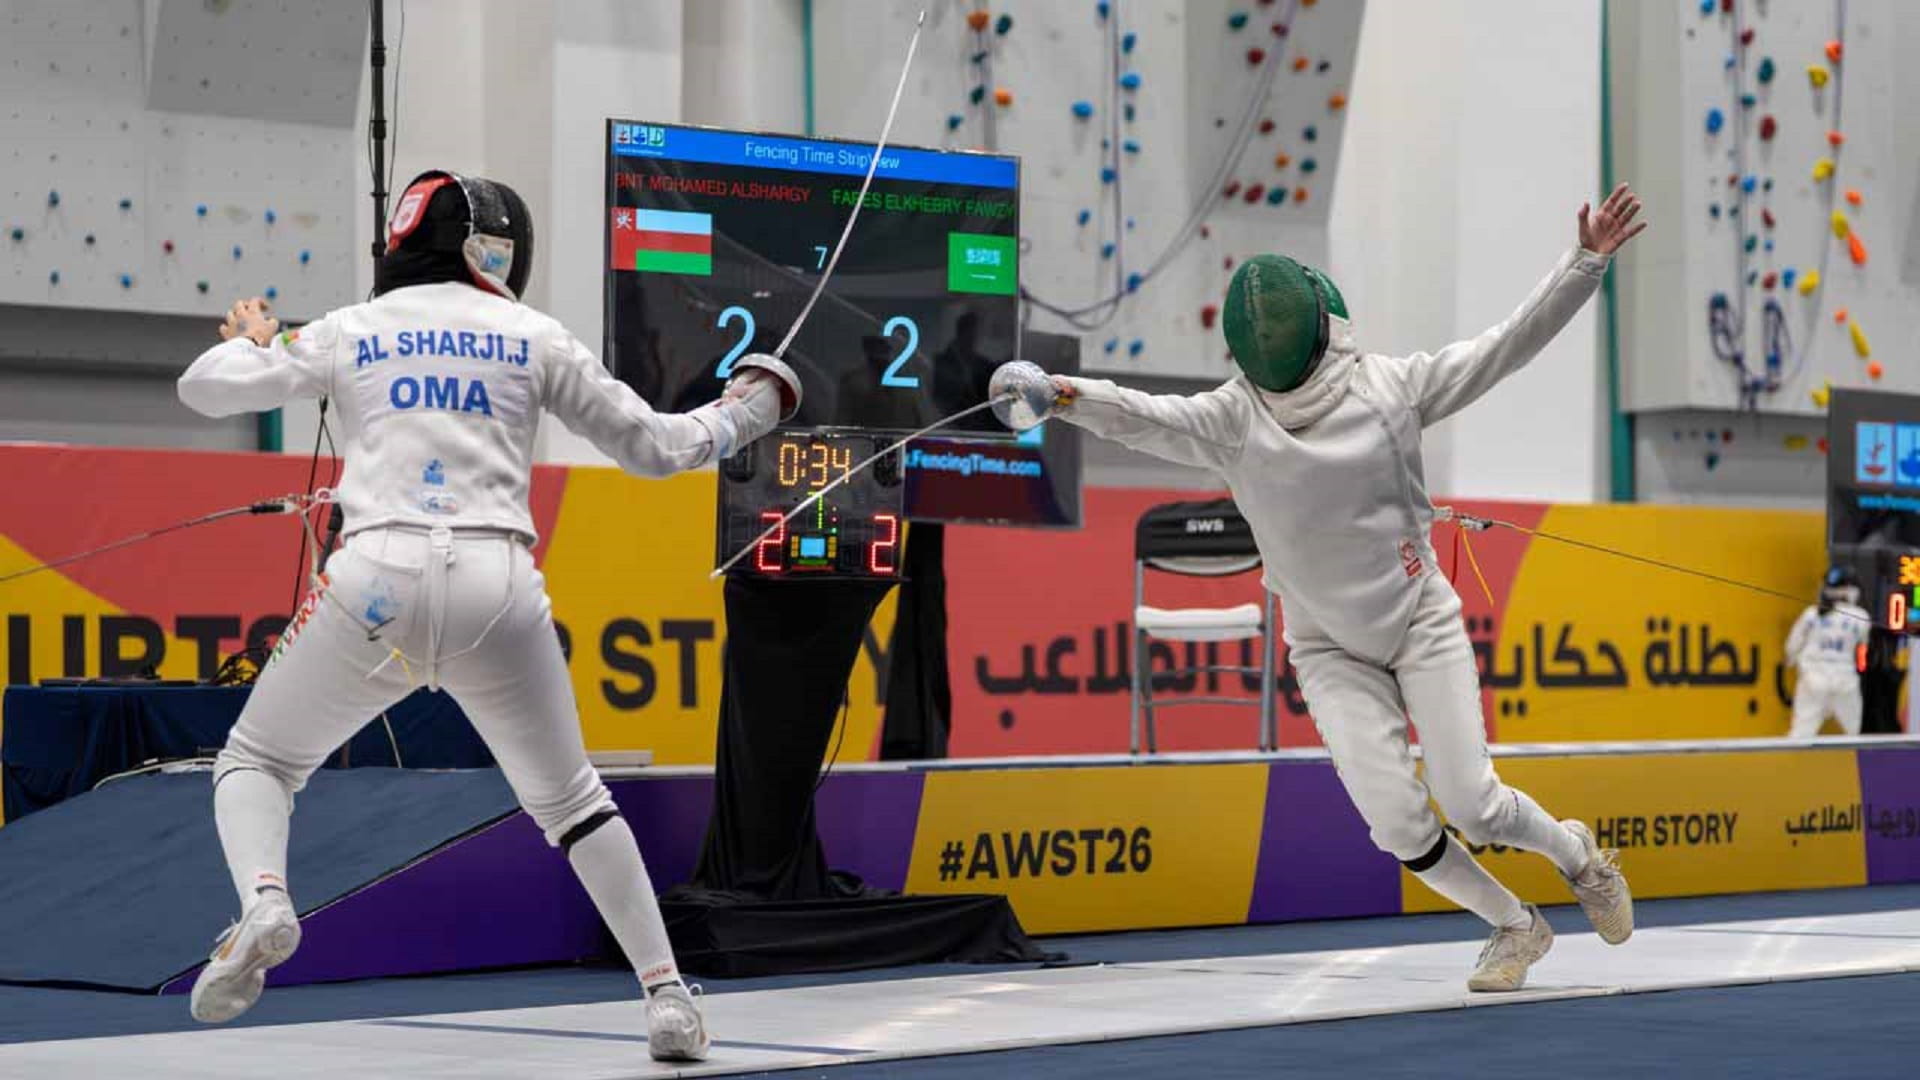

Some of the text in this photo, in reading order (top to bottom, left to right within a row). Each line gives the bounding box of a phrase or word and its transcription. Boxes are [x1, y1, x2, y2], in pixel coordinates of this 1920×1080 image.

[745, 141, 900, 169] Fencing Time StripVew
[649, 176, 727, 196] MOHAMED
[731, 183, 811, 202] ALSHARGY
[814, 246, 828, 269] 7
[356, 330, 529, 368] AL SHARJI.J
[716, 306, 756, 379] 2
[881, 317, 920, 387] 2
[389, 375, 493, 417] OMA
[779, 443, 850, 486] 0:34
[759, 512, 784, 571] 2
[871, 514, 896, 572] 2
[1889, 593, 1905, 630] 0
[600, 617, 889, 712] STY
[1644, 616, 1761, 715] بطلة
[1596, 810, 1738, 848] HER STORY
[939, 826, 1152, 882] #AWST26
